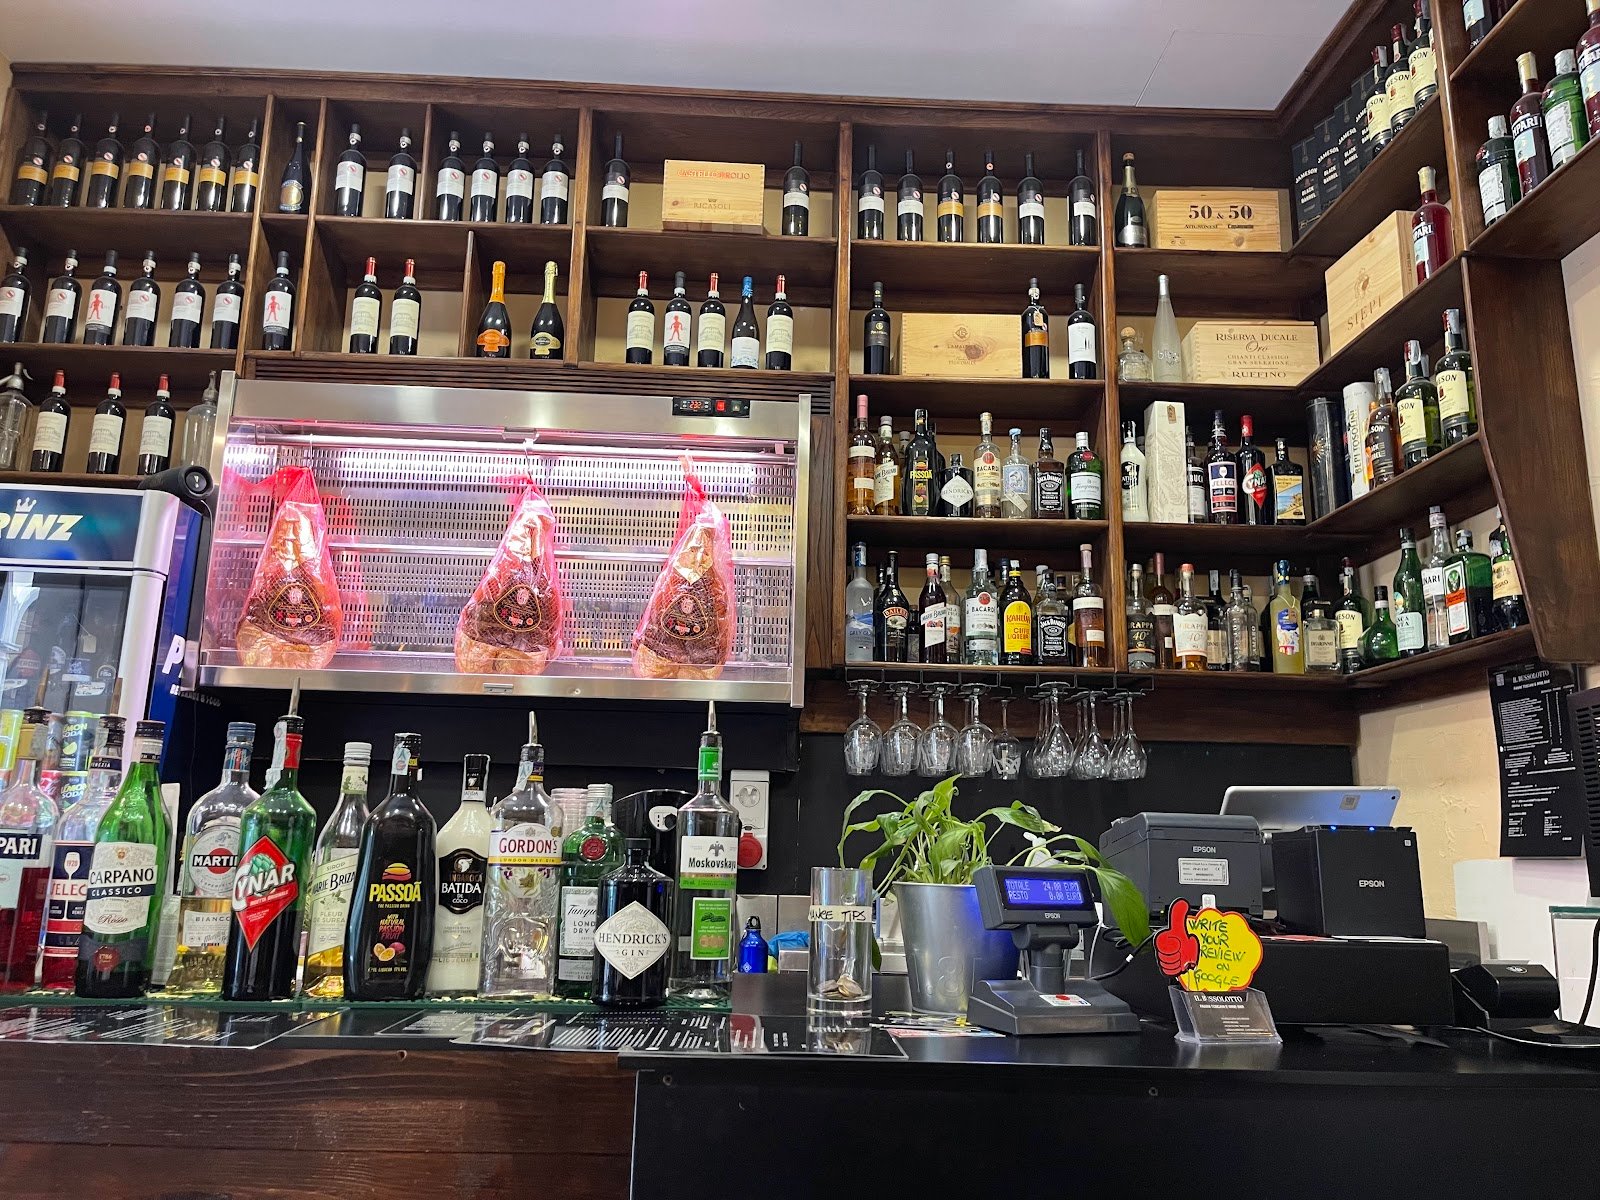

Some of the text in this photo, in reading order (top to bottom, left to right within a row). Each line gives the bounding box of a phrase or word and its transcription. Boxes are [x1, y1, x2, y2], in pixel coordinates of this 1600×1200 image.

[1188, 205, 1253, 220] 50 & 50
[1216, 333, 1298, 341] RISERVA DUCALE
[1232, 371, 1286, 379] RUFFINO
[499, 838, 558, 854] GORDON'S
[1193, 846, 1216, 854] EPSON
[90, 867, 154, 885] CARPANO
[232, 863, 295, 912] CYNAR
[441, 883, 481, 894] BATIDA
[1006, 880, 1029, 891] TOTALE
[1043, 881, 1062, 891] 24.00
[1358, 880, 1385, 888] EPSON
[91, 887, 142, 897] CLASSICO
[1009, 891, 1029, 900] RESTO
[98, 913, 128, 924] Rosso
[841, 911, 866, 922] TIPS
[1188, 918, 1228, 933] WRITE
[599, 932, 667, 945] HENDRICK'S
[1201, 933, 1229, 947] YOUR
[1201, 947, 1246, 961] REVIEW
[1194, 970, 1239, 986] GOOGLE
